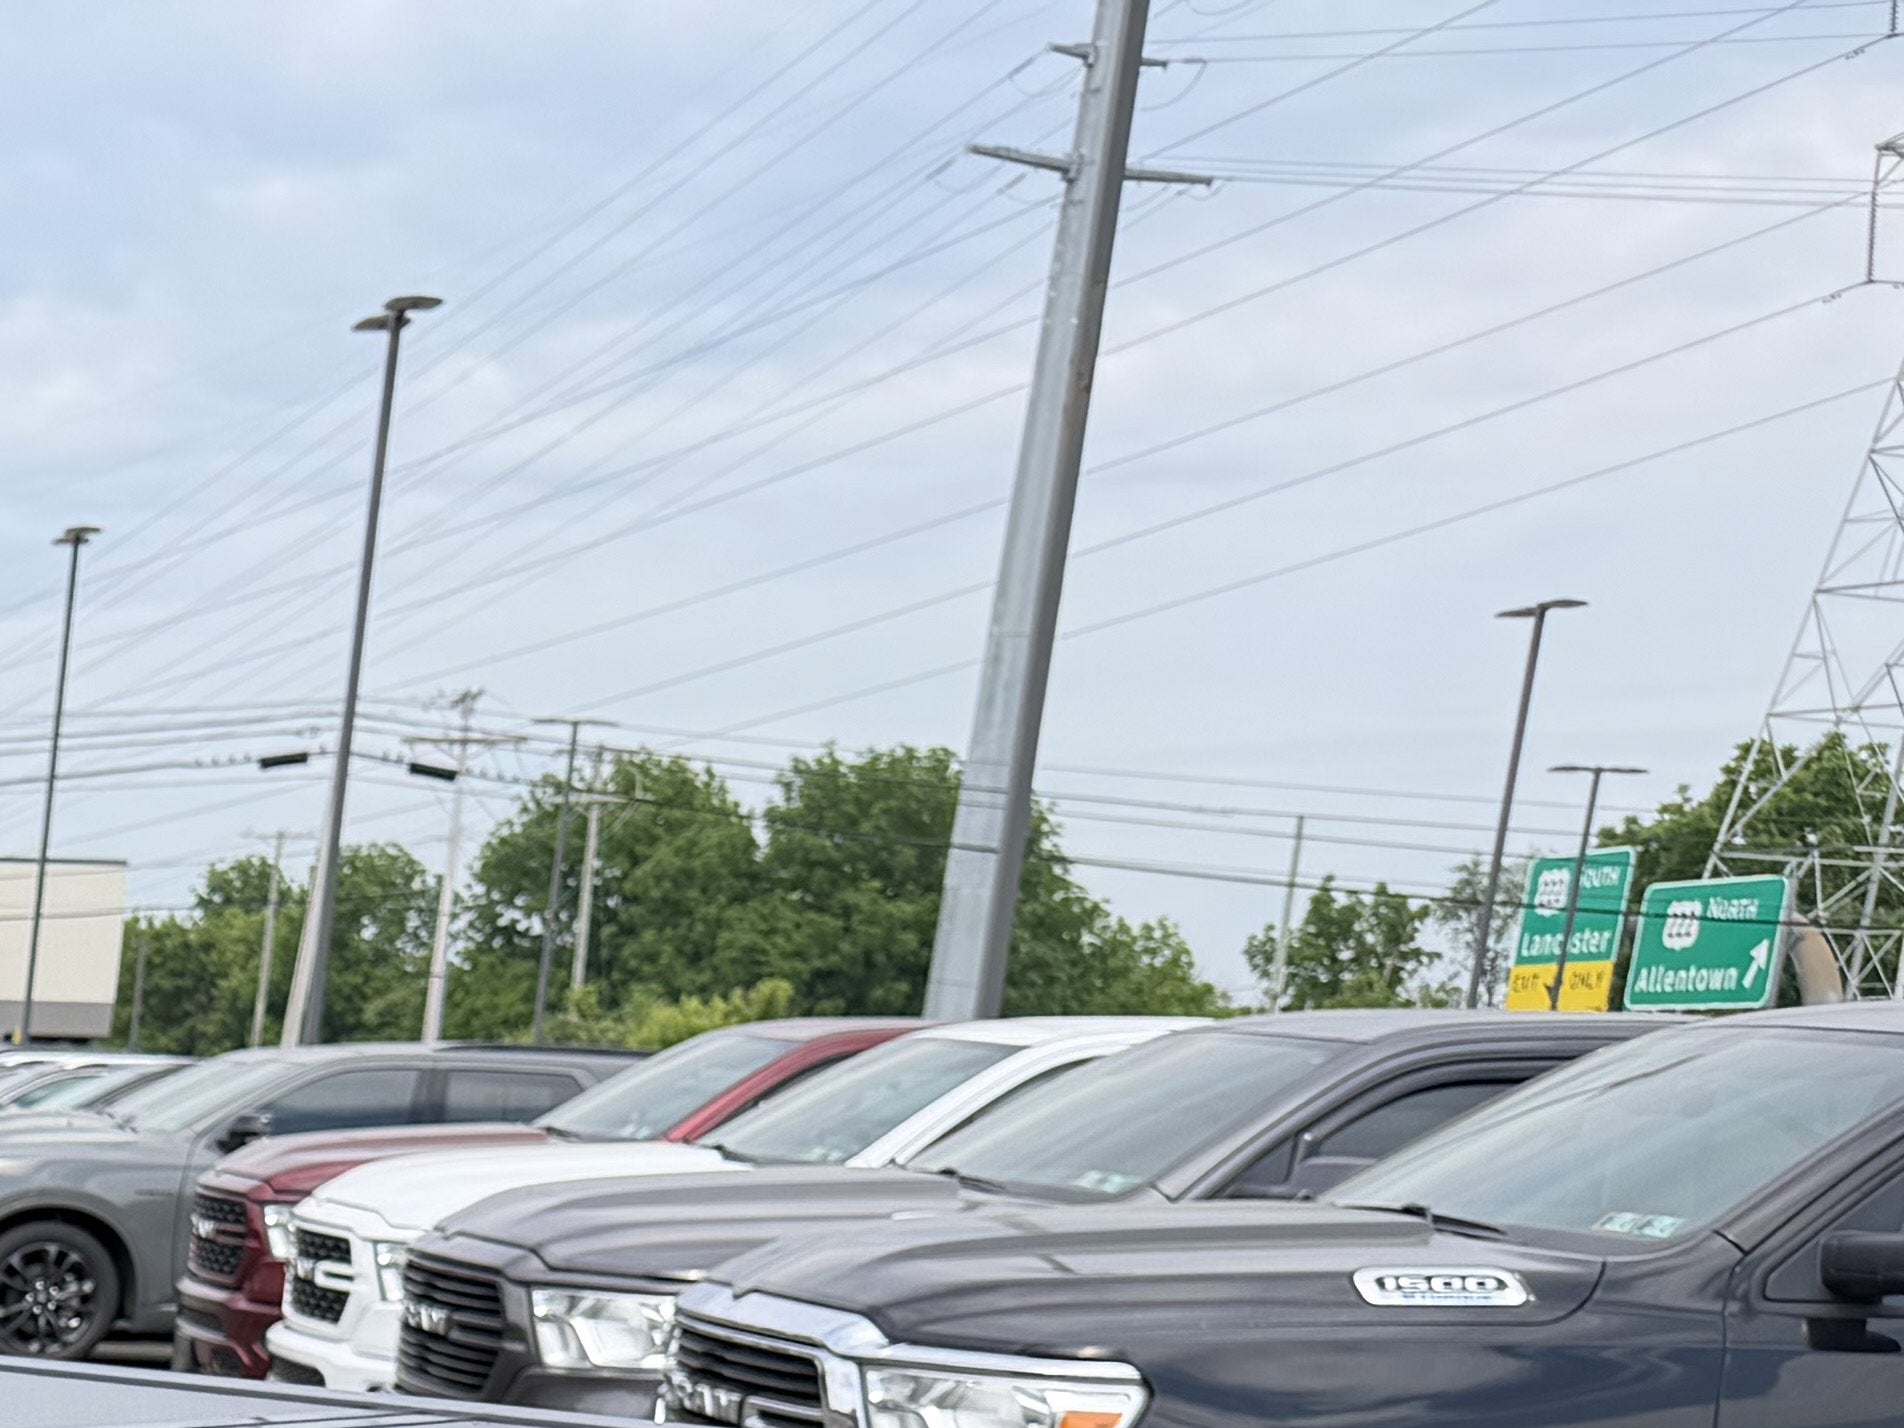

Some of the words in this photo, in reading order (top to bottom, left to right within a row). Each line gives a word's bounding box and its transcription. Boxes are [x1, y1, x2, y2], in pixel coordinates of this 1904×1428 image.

[1706, 896, 1760, 921] NORTH
[1521, 927, 1612, 957] Lancster
[1634, 964, 1738, 992] Allentown
[1380, 1275, 1501, 1293] 1500
